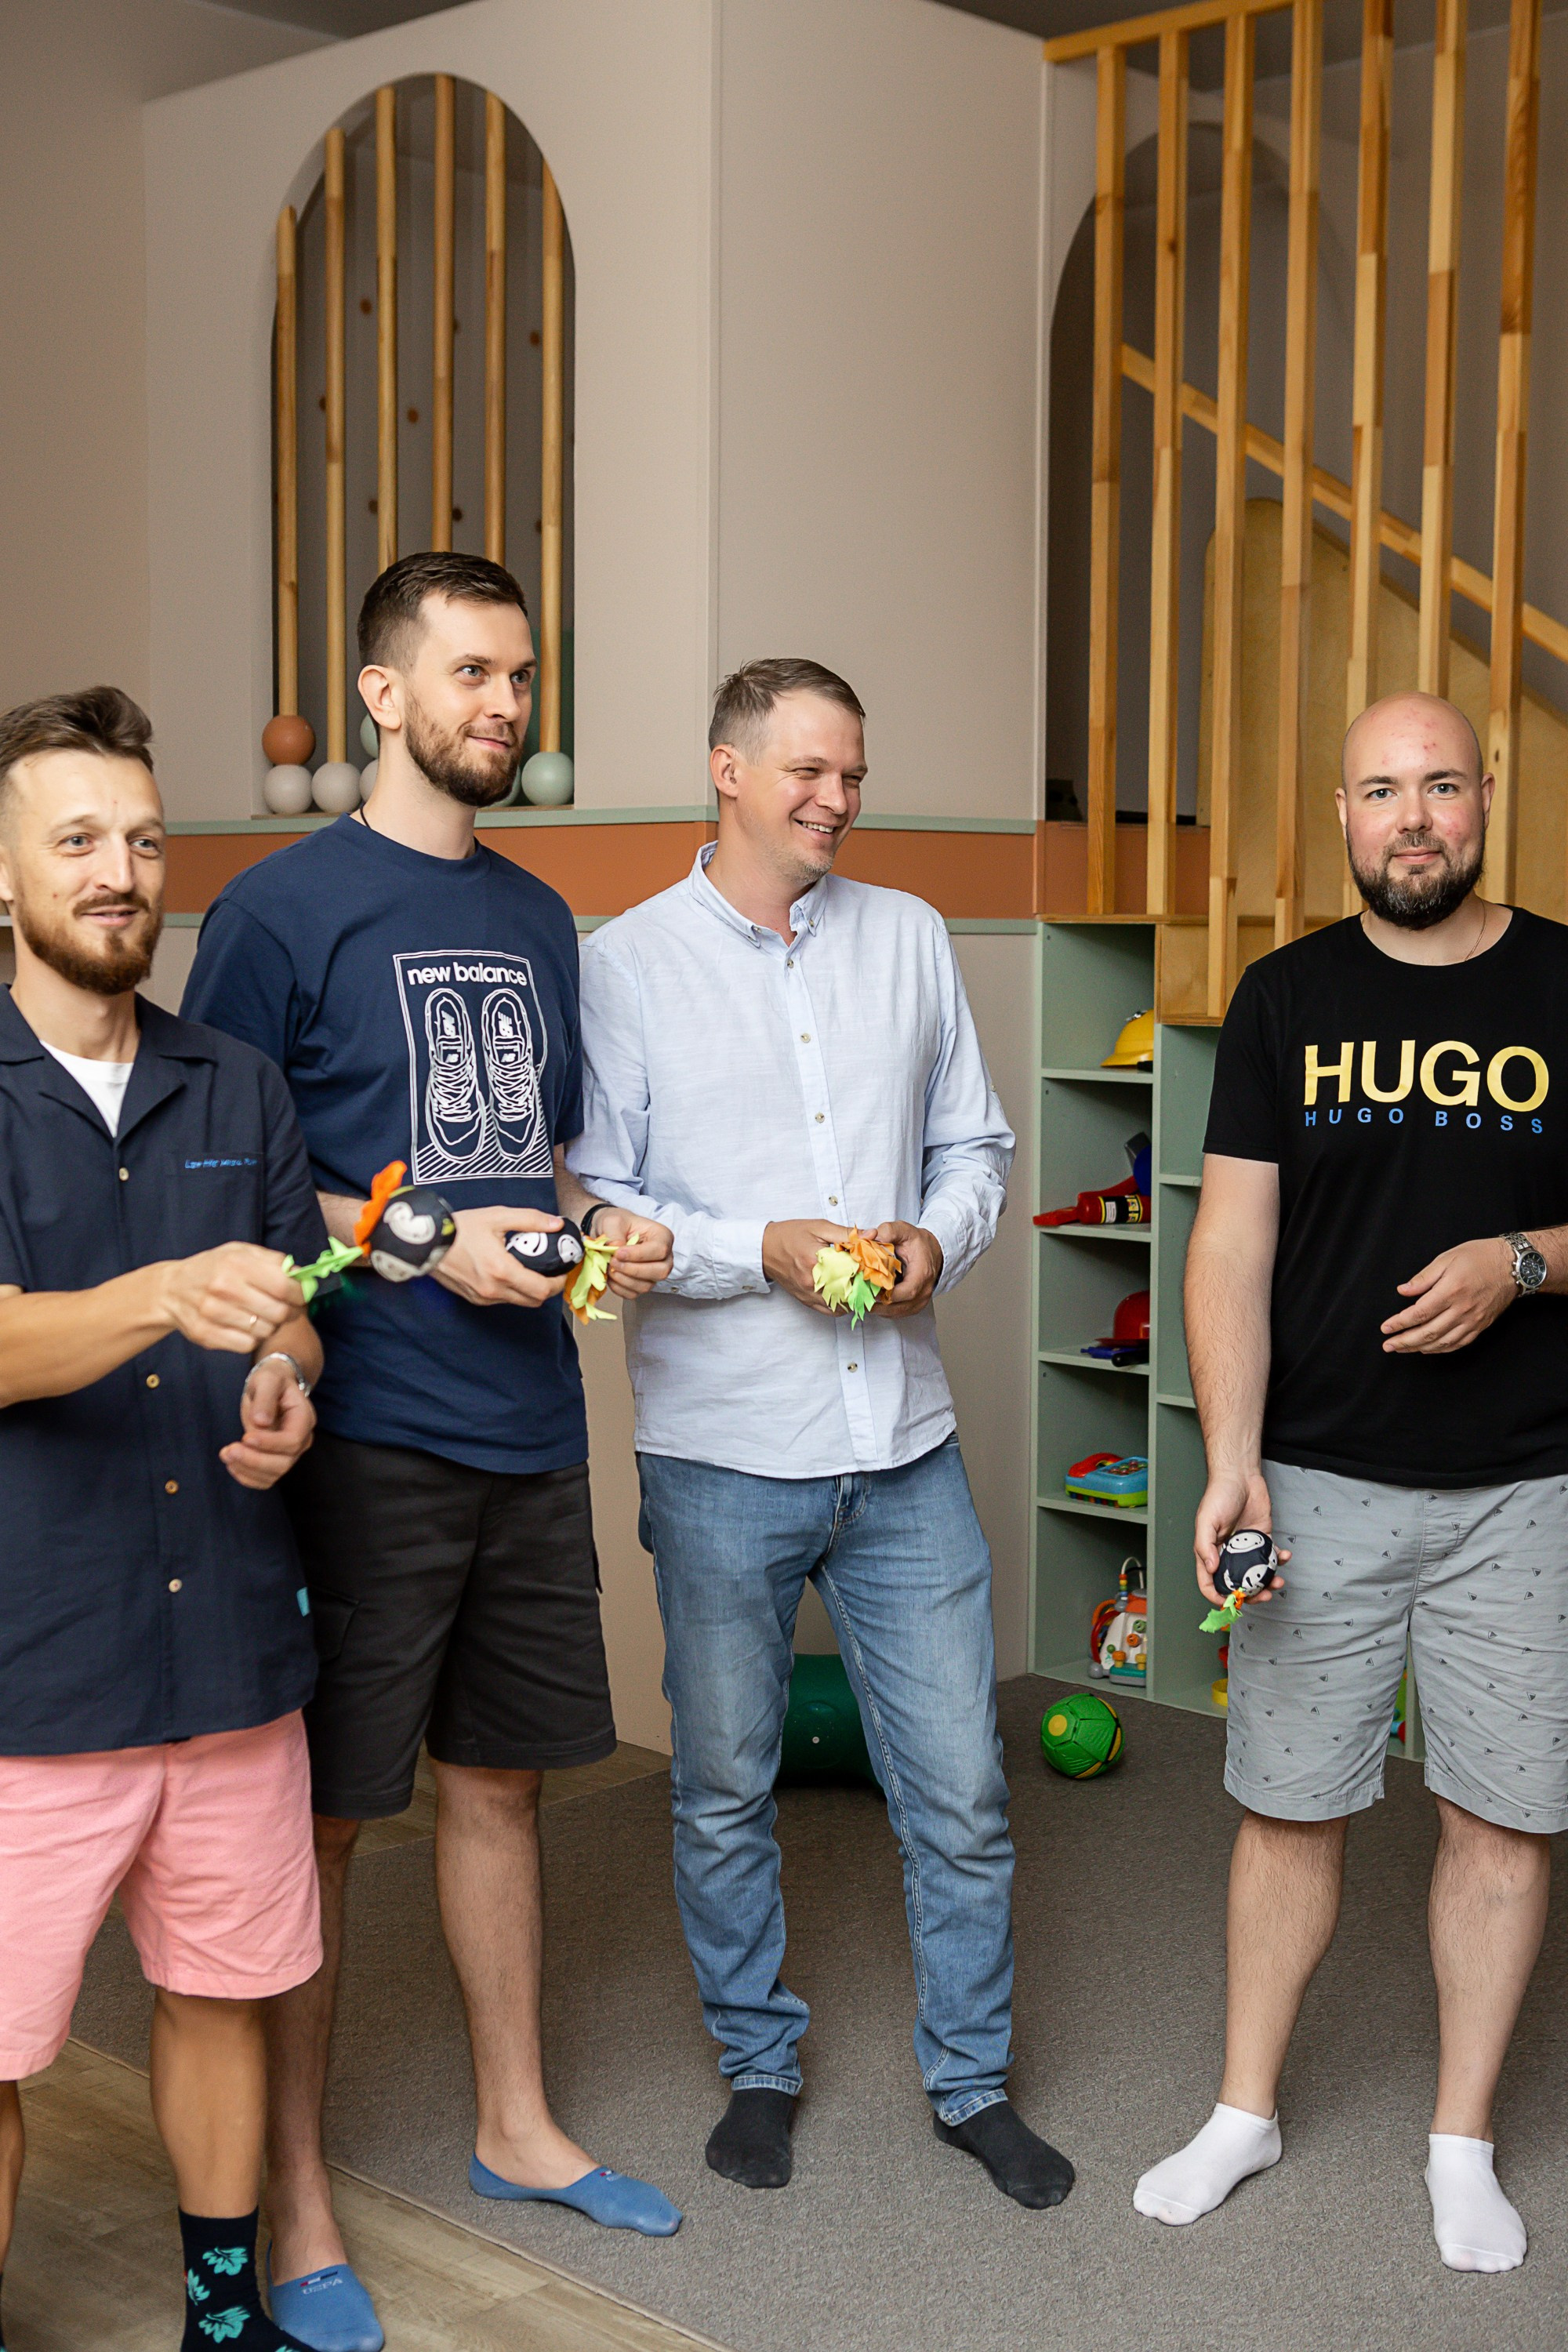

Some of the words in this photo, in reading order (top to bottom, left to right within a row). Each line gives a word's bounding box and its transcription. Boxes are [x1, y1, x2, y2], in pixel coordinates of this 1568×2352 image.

[407, 967, 451, 985] new
[452, 961, 528, 986] balance
[1303, 1040, 1550, 1112] HUGO
[1305, 1107, 1404, 1127] HUGO
[1435, 1110, 1543, 1134] BOSS
